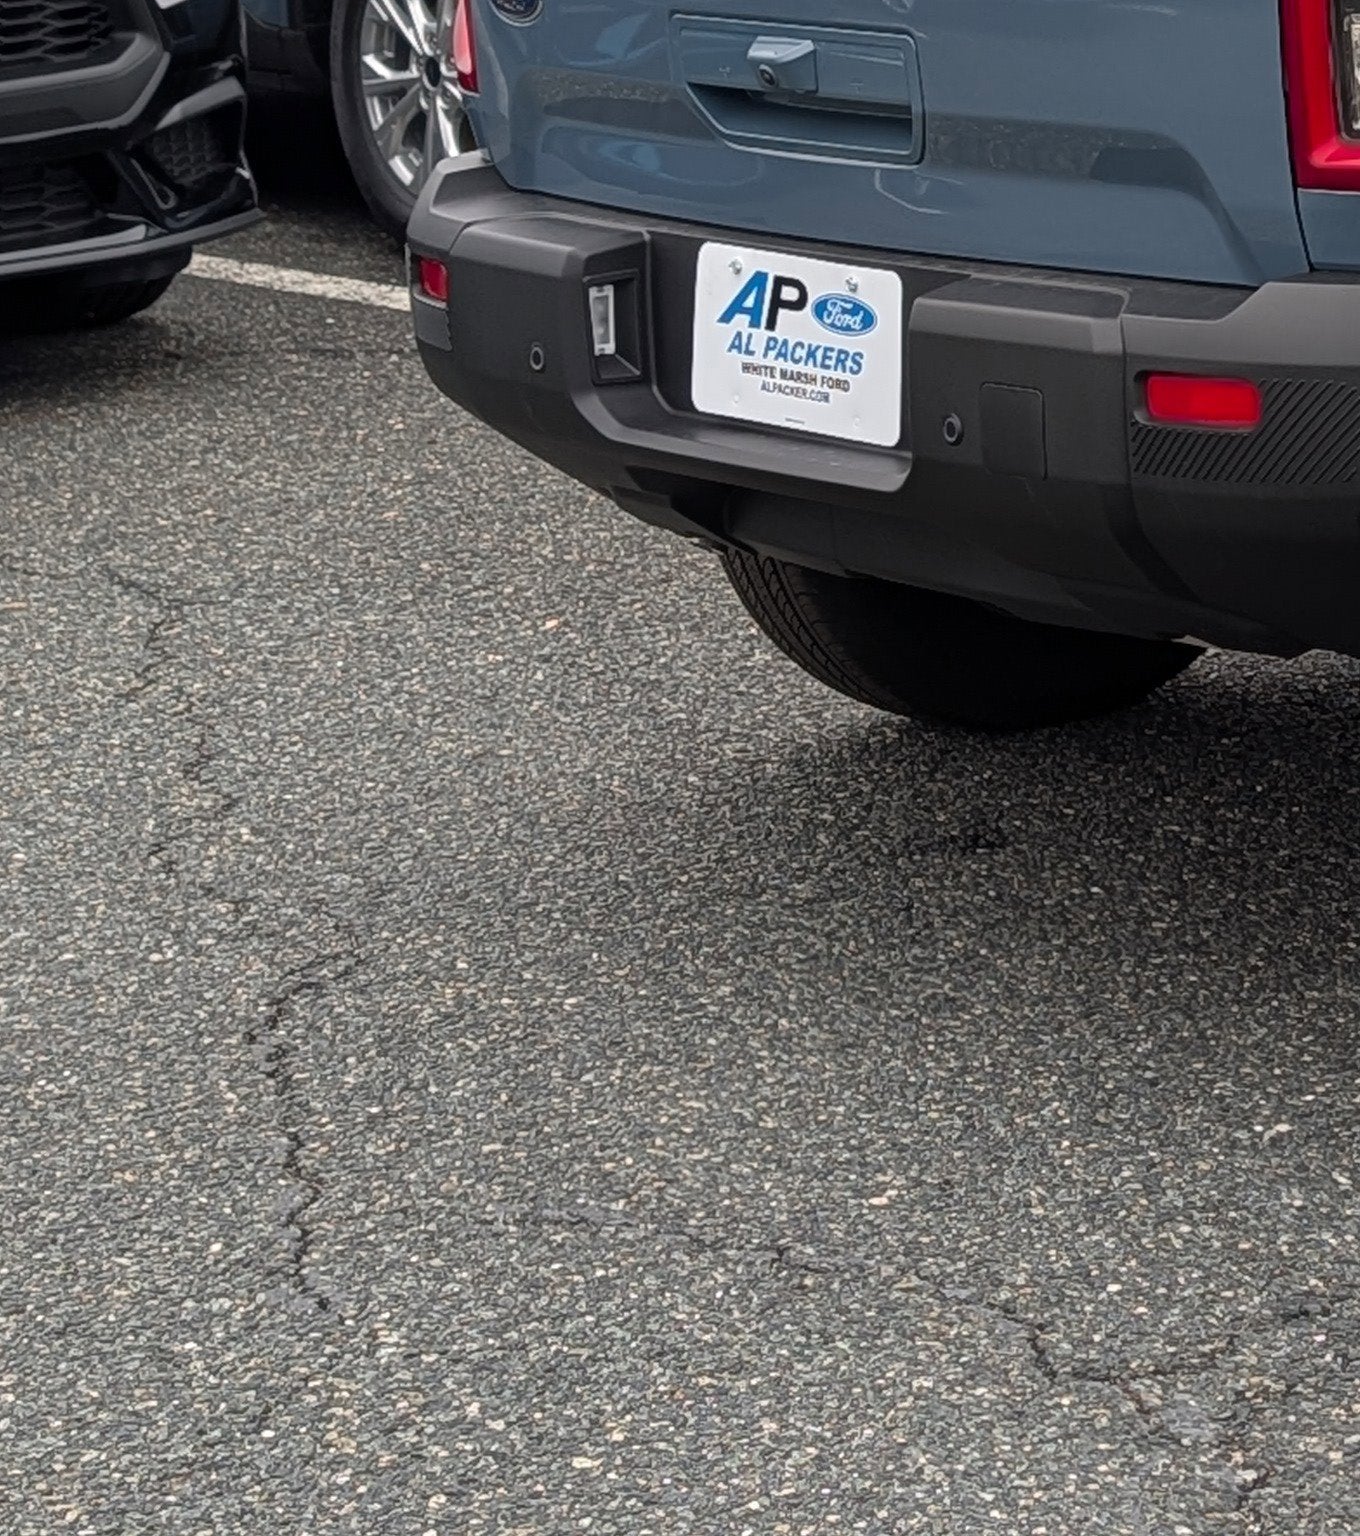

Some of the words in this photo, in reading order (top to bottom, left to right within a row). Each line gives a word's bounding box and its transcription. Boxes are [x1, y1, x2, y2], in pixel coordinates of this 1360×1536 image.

[716, 269, 809, 332] AP
[820, 296, 868, 333] Ford
[726, 331, 756, 357] AL
[762, 335, 864, 376] PACKERS
[741, 362, 777, 379] WHITE
[780, 367, 818, 386] MARSH
[820, 375, 851, 393] FORD
